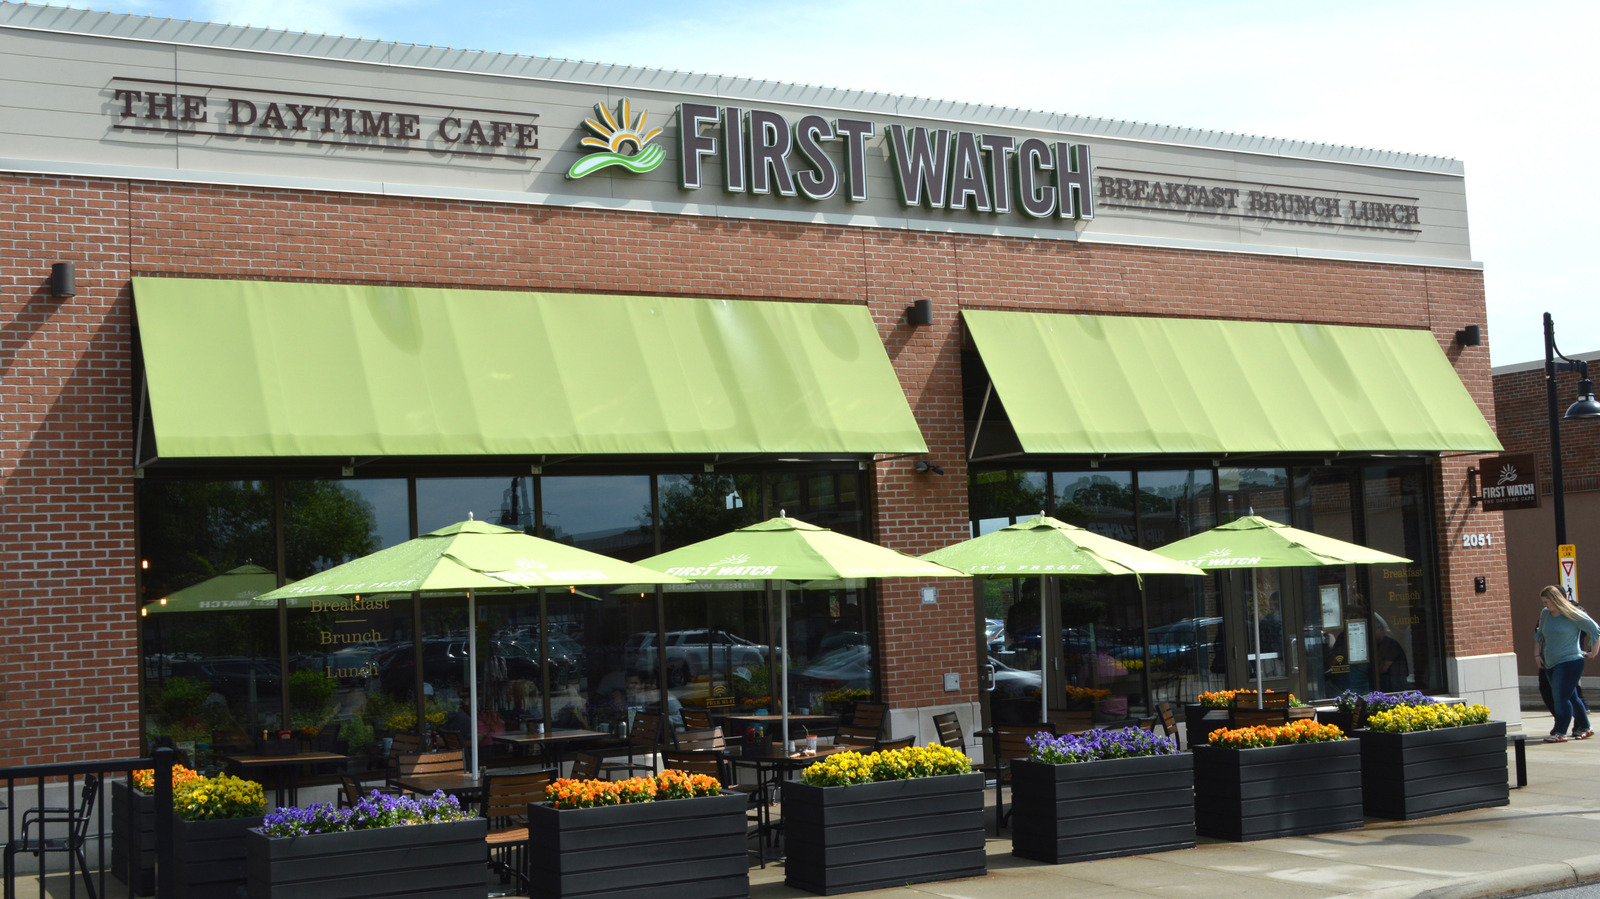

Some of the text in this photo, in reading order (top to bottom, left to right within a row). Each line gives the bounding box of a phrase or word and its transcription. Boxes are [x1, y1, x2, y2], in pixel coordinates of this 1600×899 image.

[114, 89, 540, 150] THE DAYTIME CAFE
[675, 102, 1095, 221] FIRST WATCH
[1098, 175, 1421, 225] BREAKFAST BRUNCH LUNCH
[1482, 483, 1535, 499] FIRST WATCH
[1463, 534, 1492, 547] 2051
[1207, 556, 1262, 566] WATCH
[664, 565, 778, 576] FIRST WATCH
[1383, 568, 1423, 579] Breakfast
[1389, 591, 1421, 601] Brunch
[310, 597, 390, 613] Breakfast
[1393, 614, 1420, 625] Lunch
[320, 629, 381, 645] Brunch
[326, 664, 379, 679] Lunch
